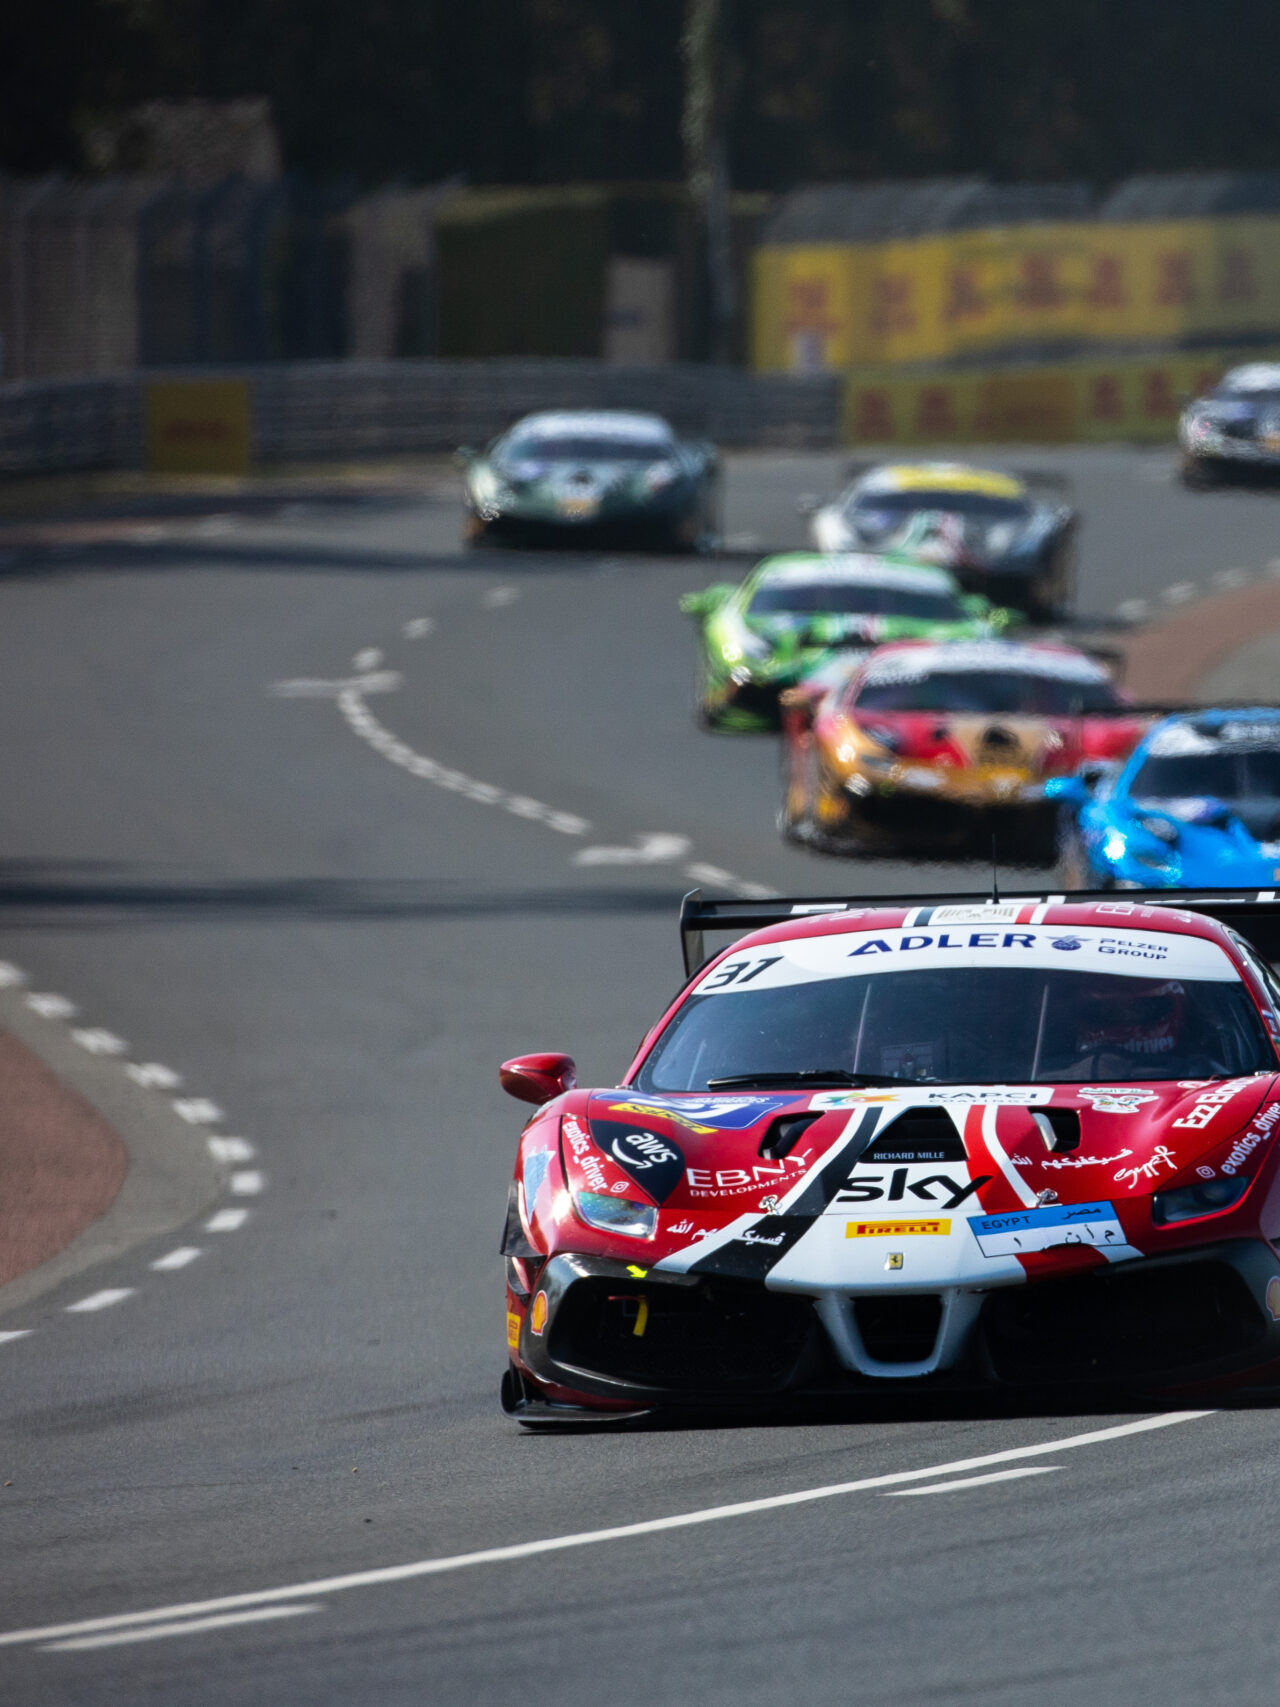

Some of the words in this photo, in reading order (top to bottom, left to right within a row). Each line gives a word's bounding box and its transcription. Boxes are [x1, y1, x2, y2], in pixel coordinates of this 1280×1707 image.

[847, 932, 1036, 957] ADLER
[1098, 946, 1169, 960] GROUP
[1099, 938, 1169, 953] PELZER
[562, 1121, 608, 1192] exotics_driver
[625, 1132, 679, 1163] aws
[873, 1152, 915, 1160] RICHARD
[917, 1151, 945, 1159] MILLE
[686, 1148, 813, 1188] EBNY
[690, 1169, 808, 1198] DEVELOPMENTS
[835, 1168, 994, 1209] sky
[981, 1215, 1031, 1230] EGYPT
[1061, 1207, 1102, 1220] مصر
[856, 1222, 940, 1235] PIRELLI
